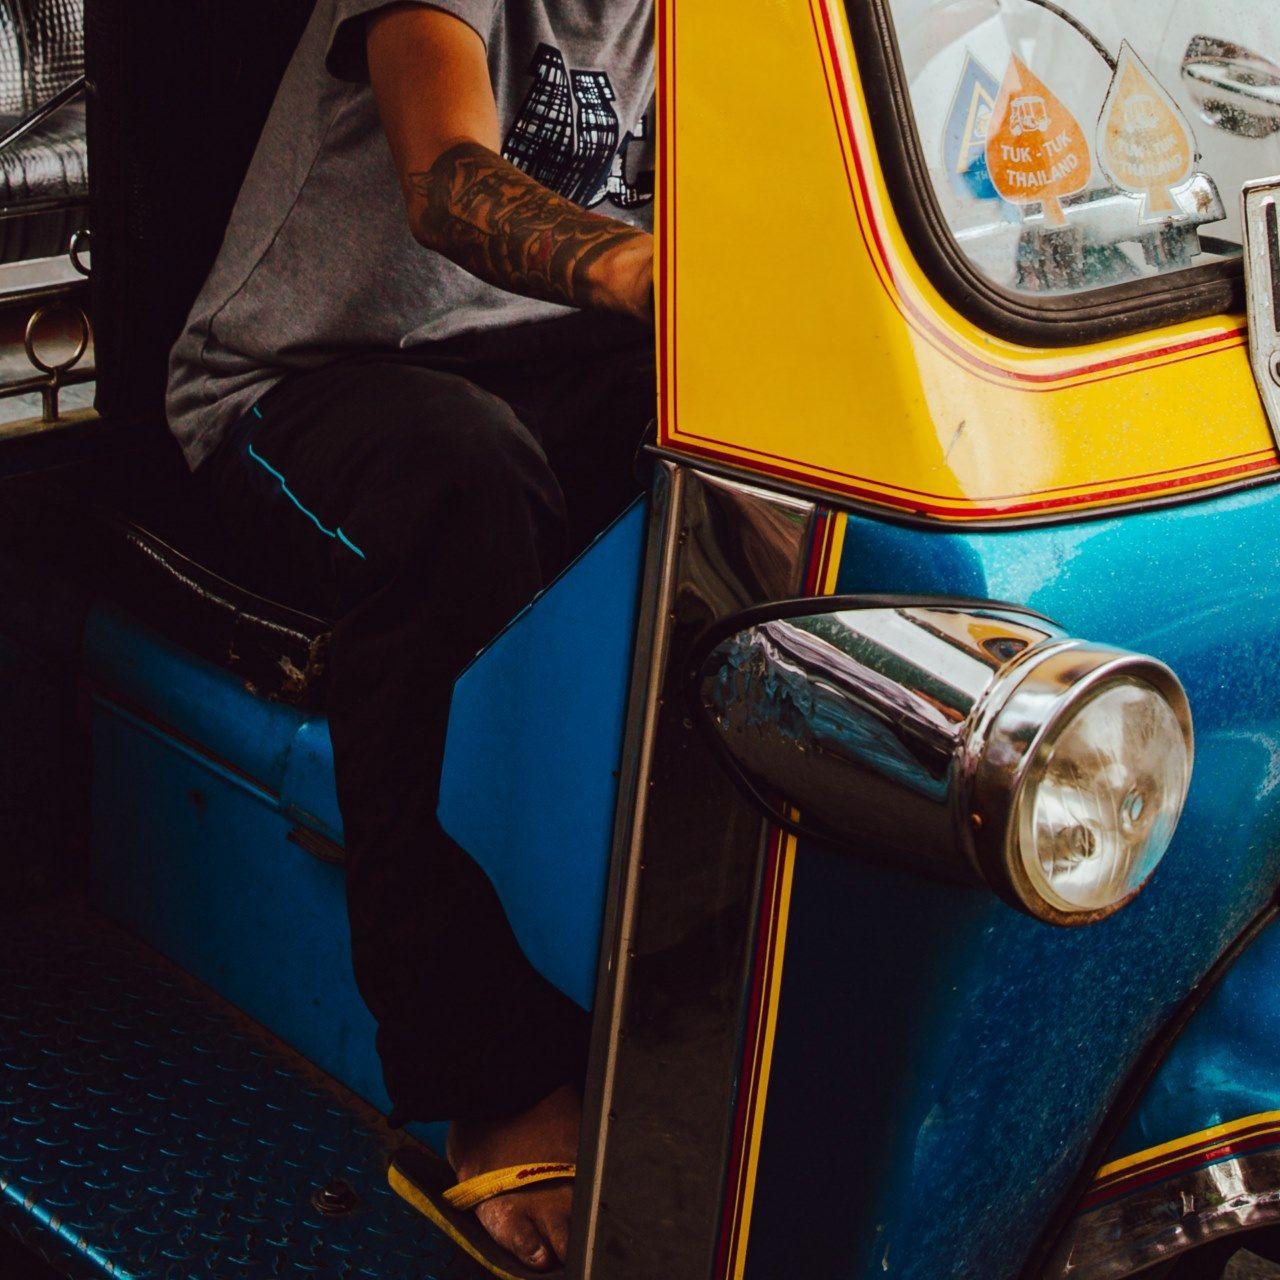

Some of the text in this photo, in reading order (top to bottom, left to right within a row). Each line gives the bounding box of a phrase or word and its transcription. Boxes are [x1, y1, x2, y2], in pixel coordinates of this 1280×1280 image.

[1001, 144, 1032, 163] TUK
[1042, 132, 1072, 157] TUK
[1006, 153, 1078, 188] THAILAND
